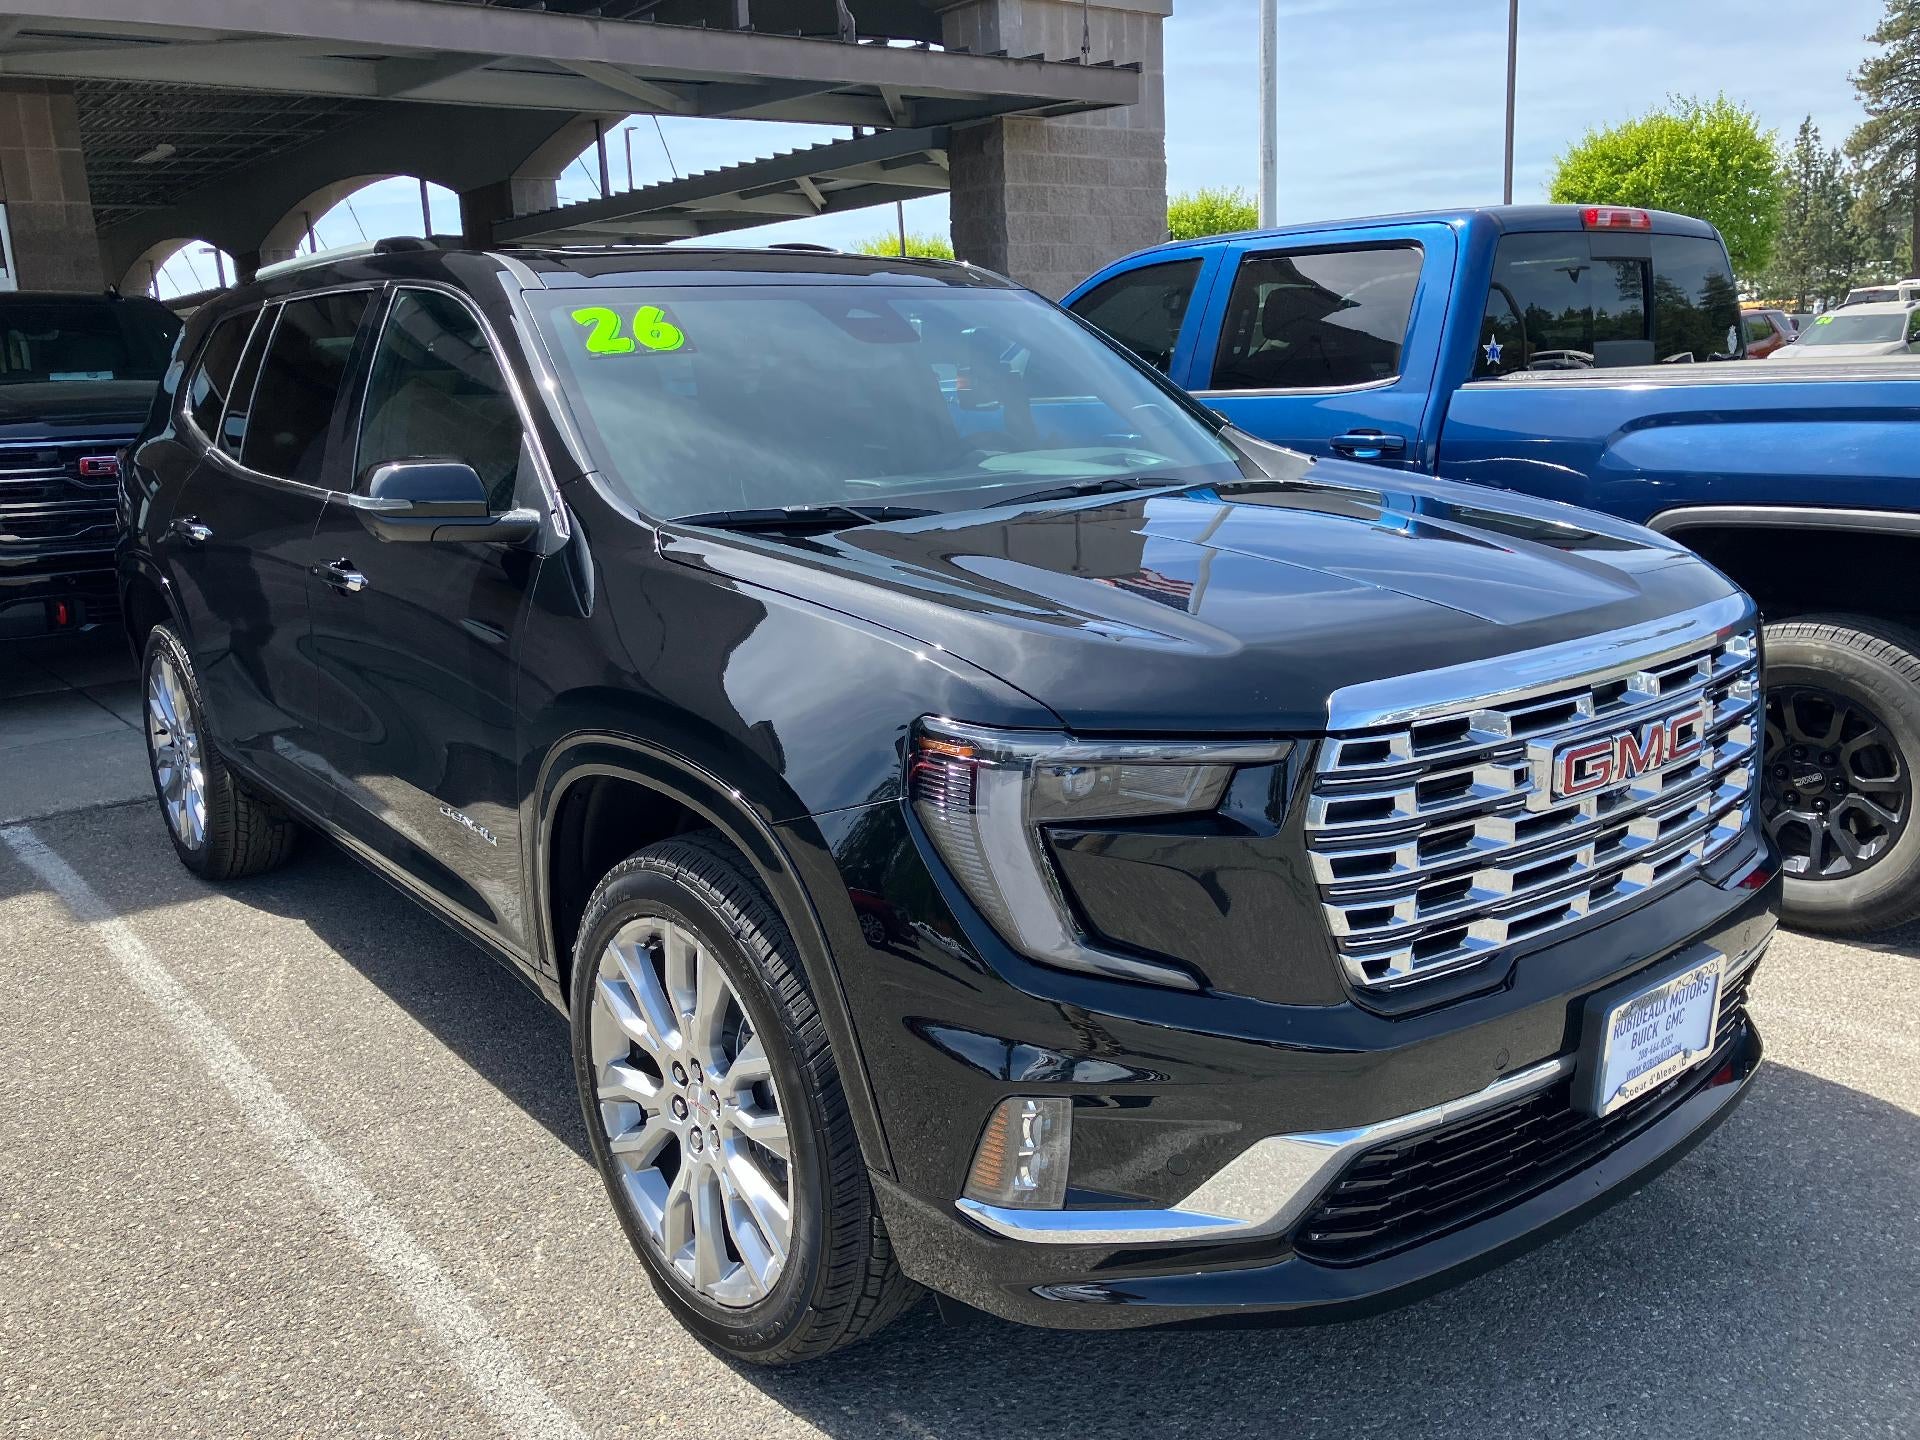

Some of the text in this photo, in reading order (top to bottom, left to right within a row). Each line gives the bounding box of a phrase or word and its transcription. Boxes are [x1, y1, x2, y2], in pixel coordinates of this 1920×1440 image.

[571, 305, 685, 354] 26
[1558, 708, 1705, 797] GMC
[1613, 977, 1710, 1040] ROBIDEAUX MOTORS
[1631, 1008, 1685, 1050] BUICK GMC
[1624, 1056, 1687, 1099] Coeur d'Alene ID
